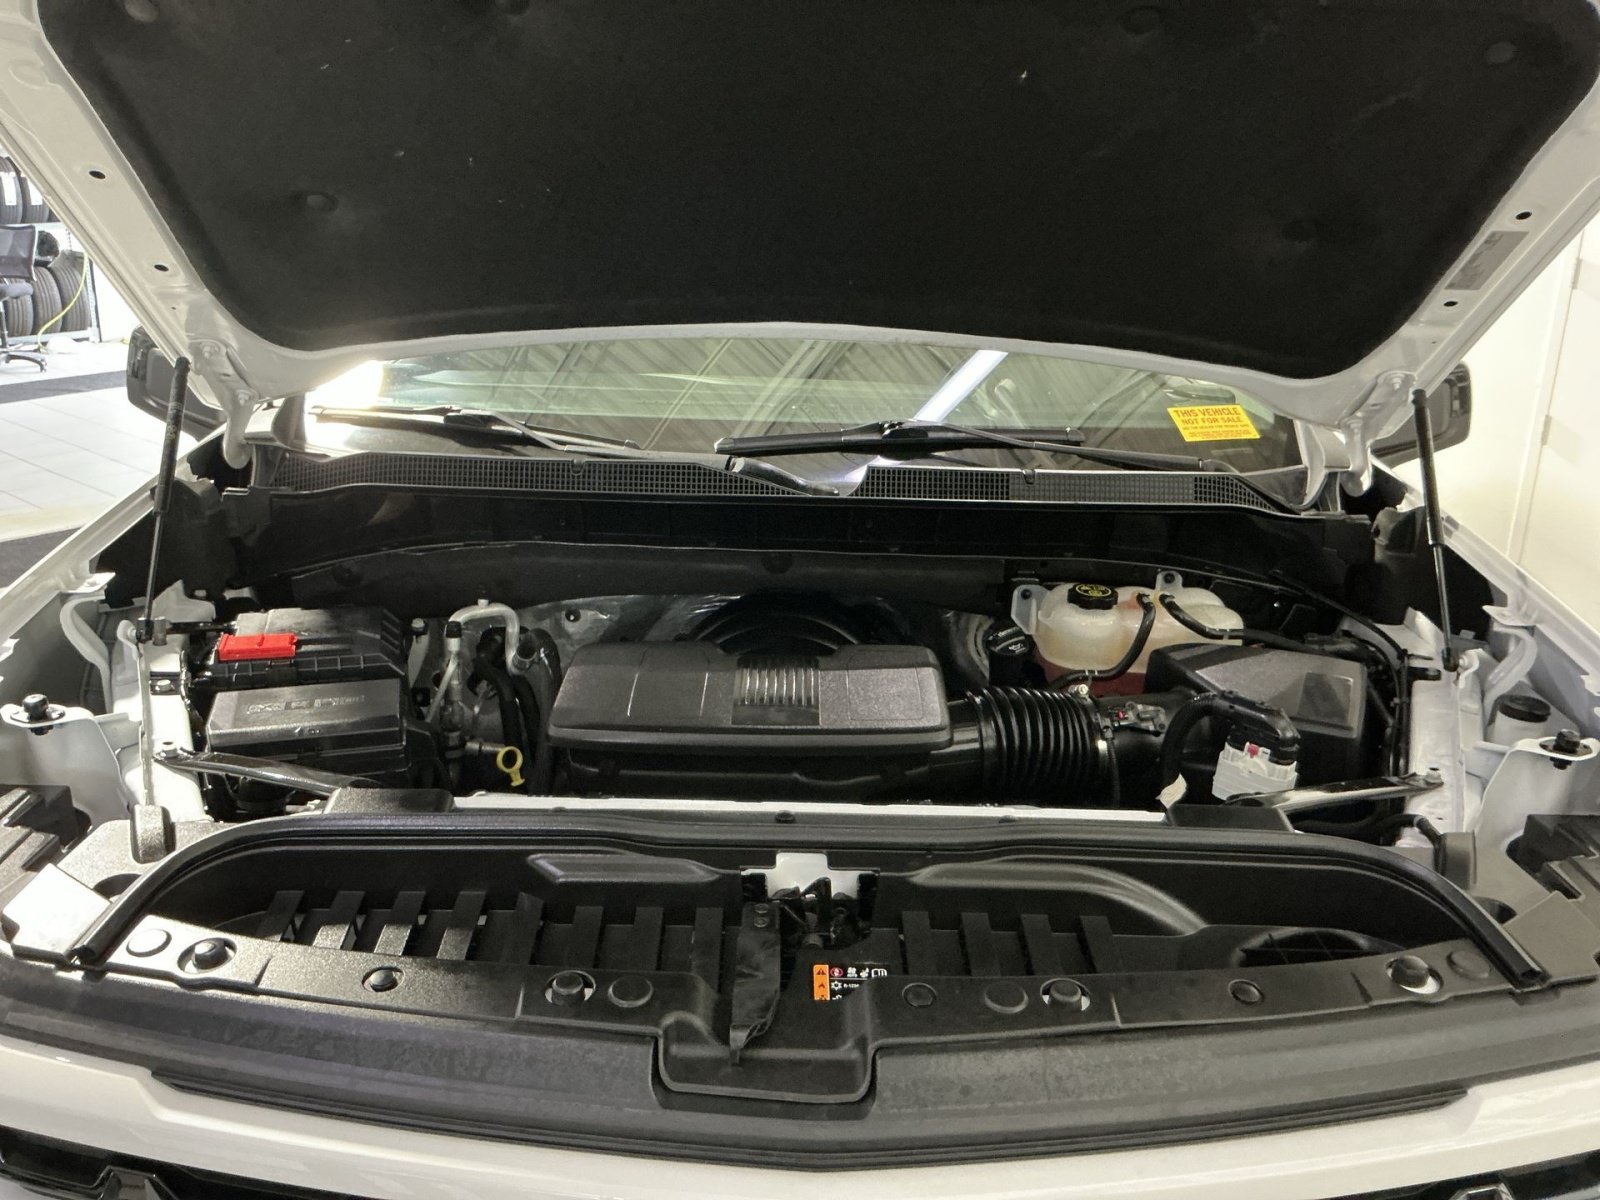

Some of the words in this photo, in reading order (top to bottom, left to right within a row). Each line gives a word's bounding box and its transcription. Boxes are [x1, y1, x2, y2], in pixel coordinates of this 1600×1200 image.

[1174, 409, 1199, 418] THIS
[1199, 407, 1241, 417] VEHICLE
[1181, 418, 1199, 426] NOT
[1202, 417, 1219, 425] FOR
[1222, 416, 1244, 424] SALE
